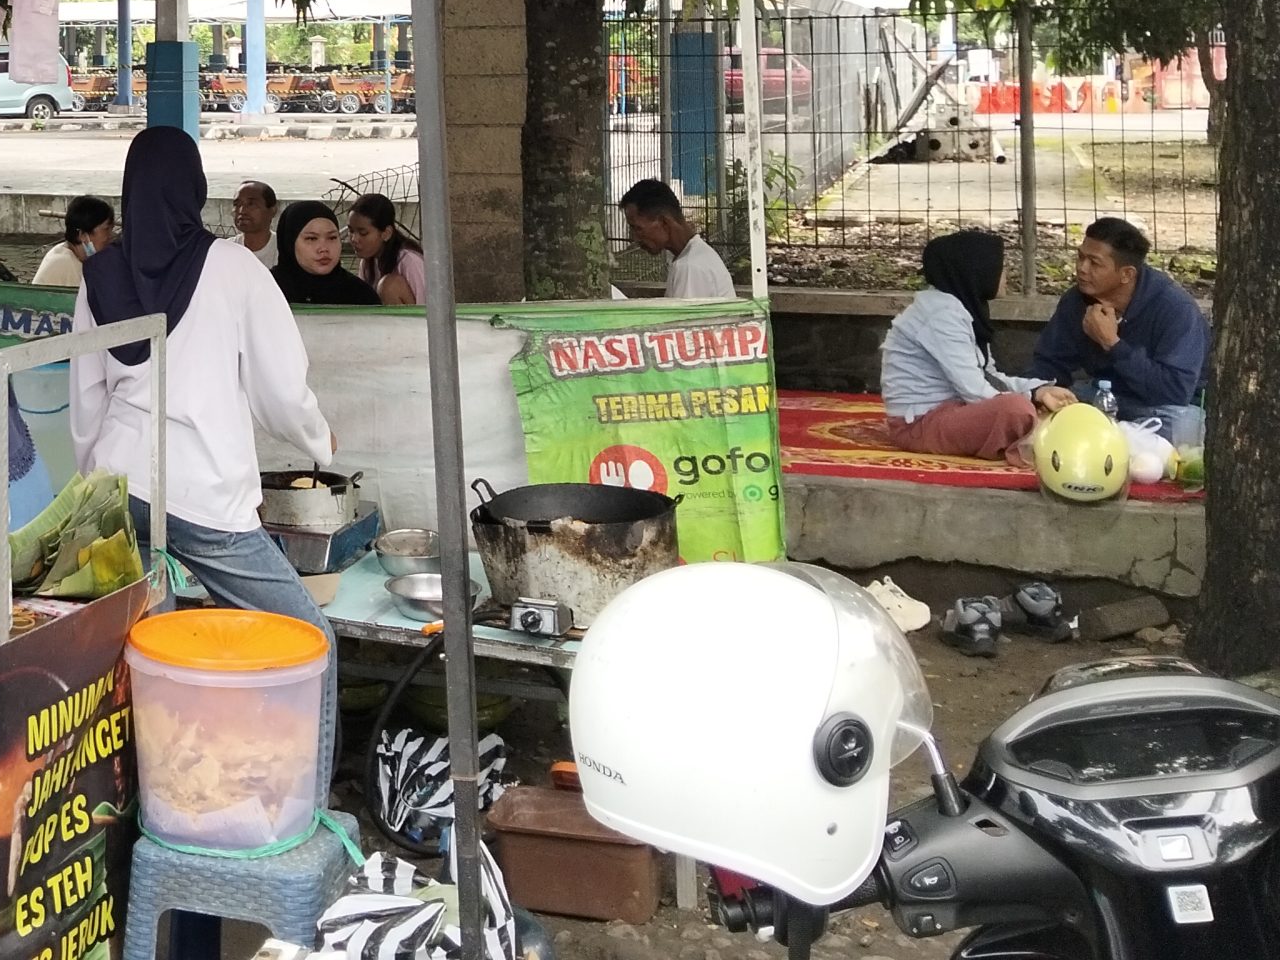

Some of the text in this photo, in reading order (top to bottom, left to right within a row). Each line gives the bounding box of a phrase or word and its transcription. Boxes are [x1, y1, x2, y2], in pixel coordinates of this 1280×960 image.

[551, 338, 640, 372] NASI
[596, 392, 686, 421] TERIMA
[578, 751, 627, 786] HONDA
[61, 794, 90, 842] ES
[16, 856, 93, 937] ES TEH
